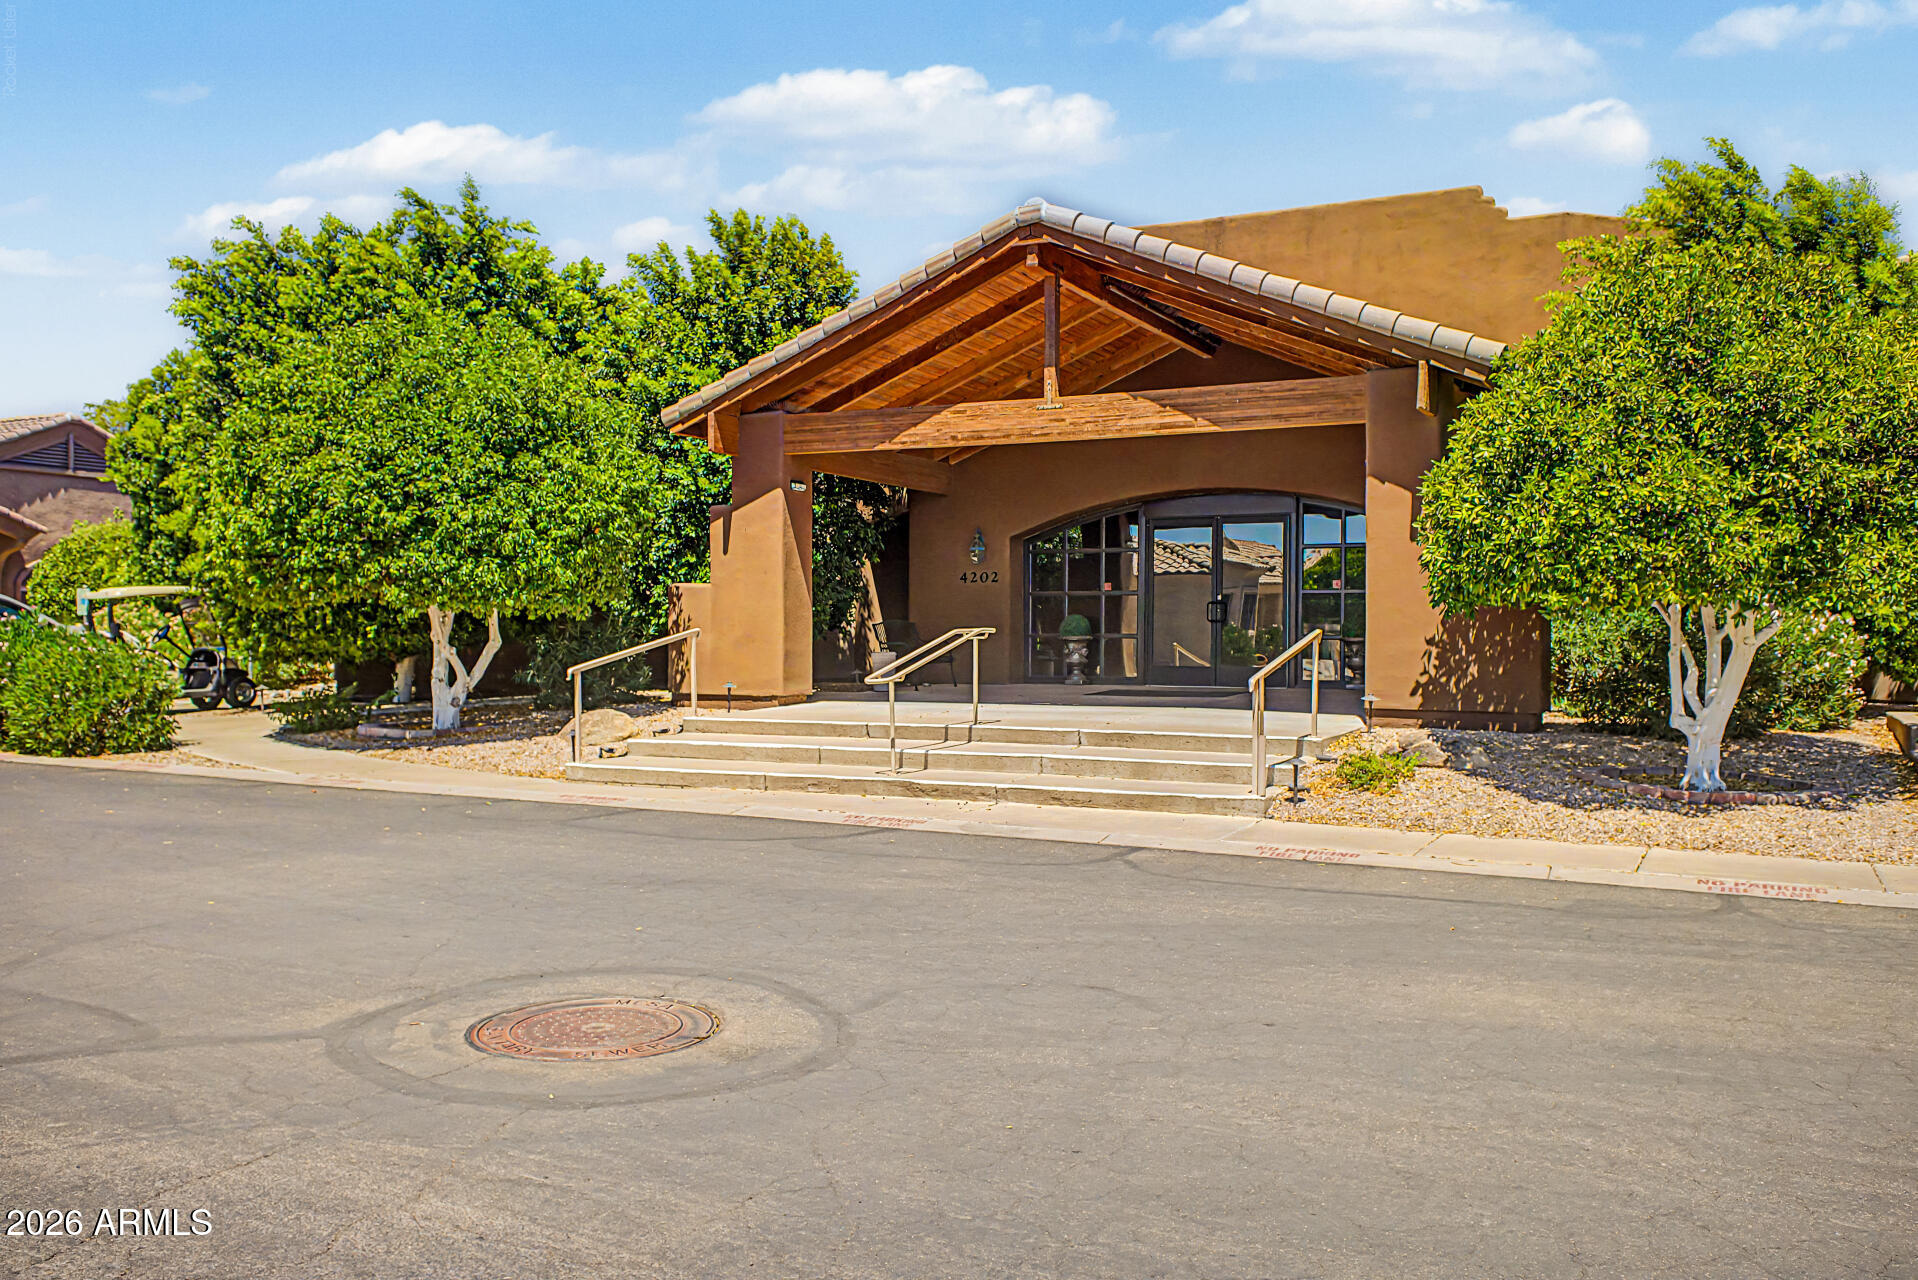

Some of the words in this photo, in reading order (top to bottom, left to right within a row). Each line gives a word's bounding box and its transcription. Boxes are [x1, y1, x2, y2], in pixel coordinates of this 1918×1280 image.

[959, 571, 999, 584] 4202
[1696, 878, 1726, 886] NO
[1733, 881, 1829, 895] PARKING
